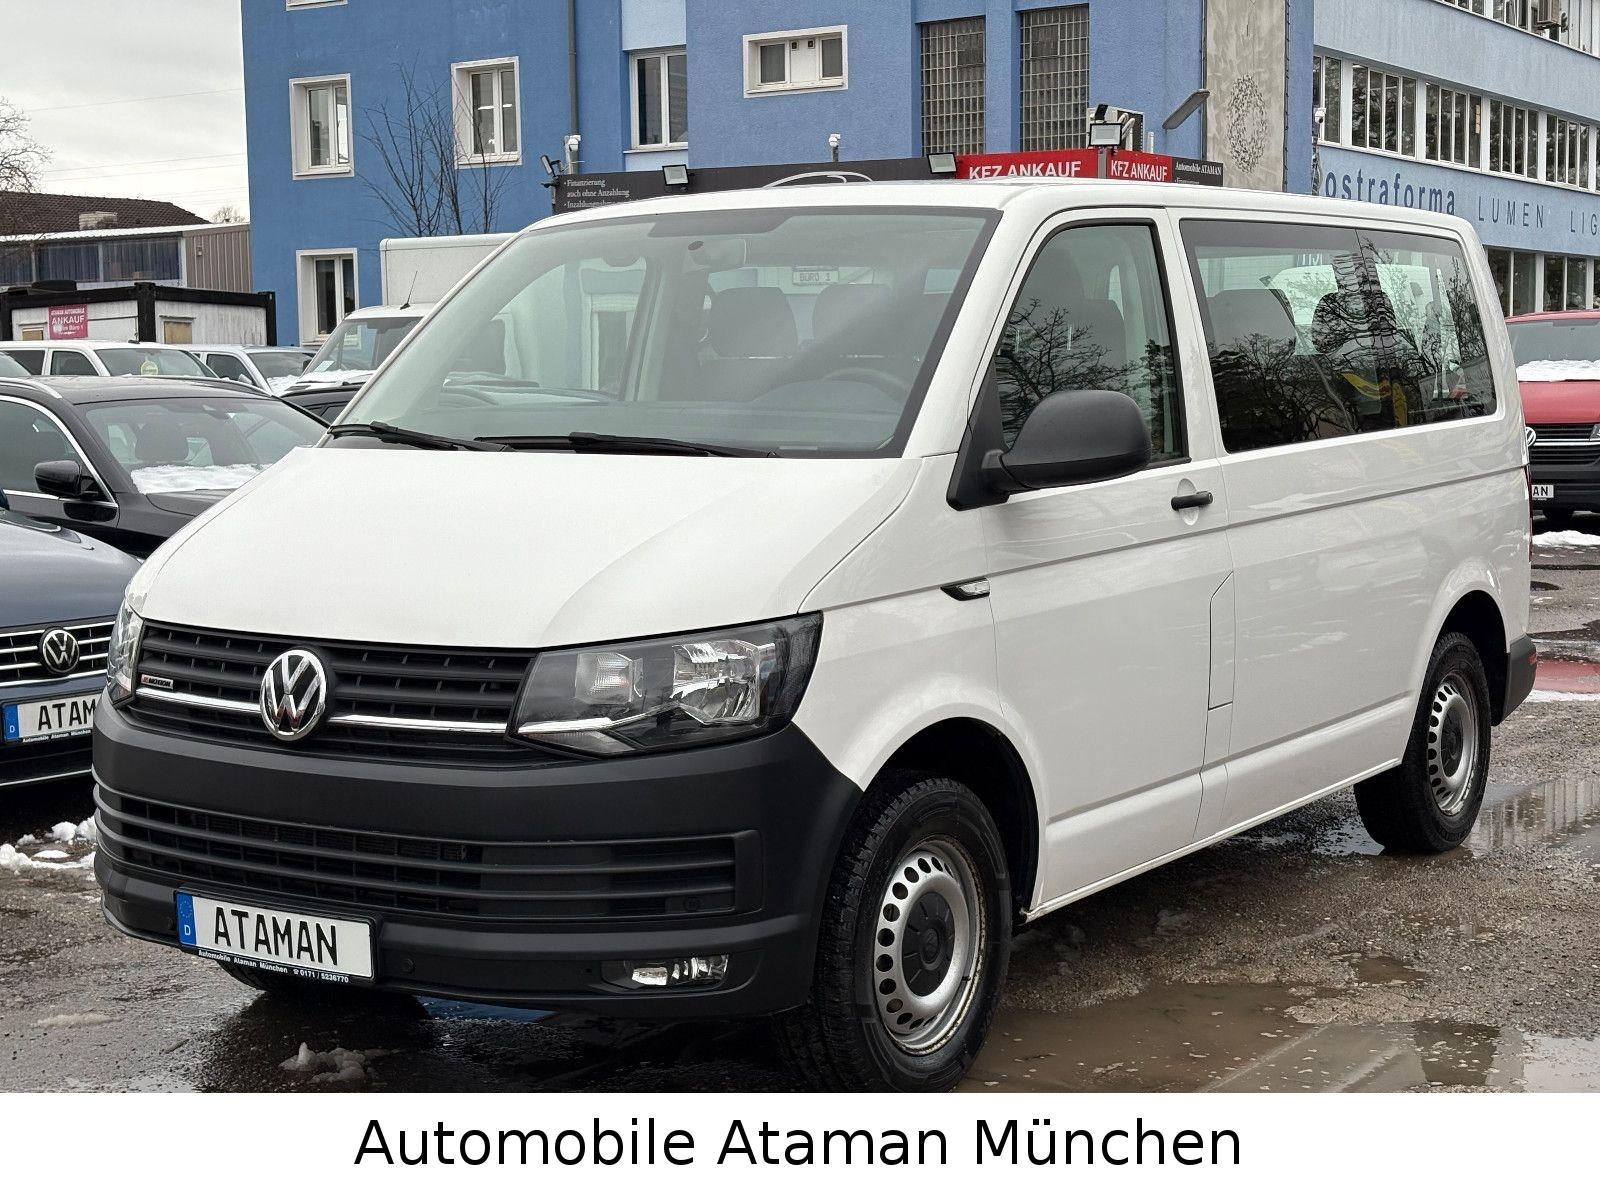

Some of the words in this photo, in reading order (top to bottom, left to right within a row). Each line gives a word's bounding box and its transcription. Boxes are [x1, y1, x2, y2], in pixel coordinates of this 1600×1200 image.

[969, 166, 1003, 179] KFZ
[1007, 160, 1082, 177] ANKAUF
[1110, 159, 1129, 177] KFZ
[1130, 163, 1168, 181] ANKAUF
[1175, 161, 1201, 173] Automobile
[1200, 164, 1222, 176] ATAMAN
[582, 189, 597, 197] ohne
[598, 188, 629, 198] Anzahlung
[1326, 169, 1454, 215] ostraforma
[1478, 196, 1544, 229] LUMEN
[1570, 210, 1598, 236] LIG
[52, 315, 85, 325] ANKAUF
[9, 725, 16, 733] D
[184, 924, 192, 936] D
[214, 906, 338, 966] ATAMAN
[198, 949, 231, 963] Automobile
[233, 956, 257, 968] Ataman
[259, 961, 288, 974] München
[300, 969, 315, 979] 0171
